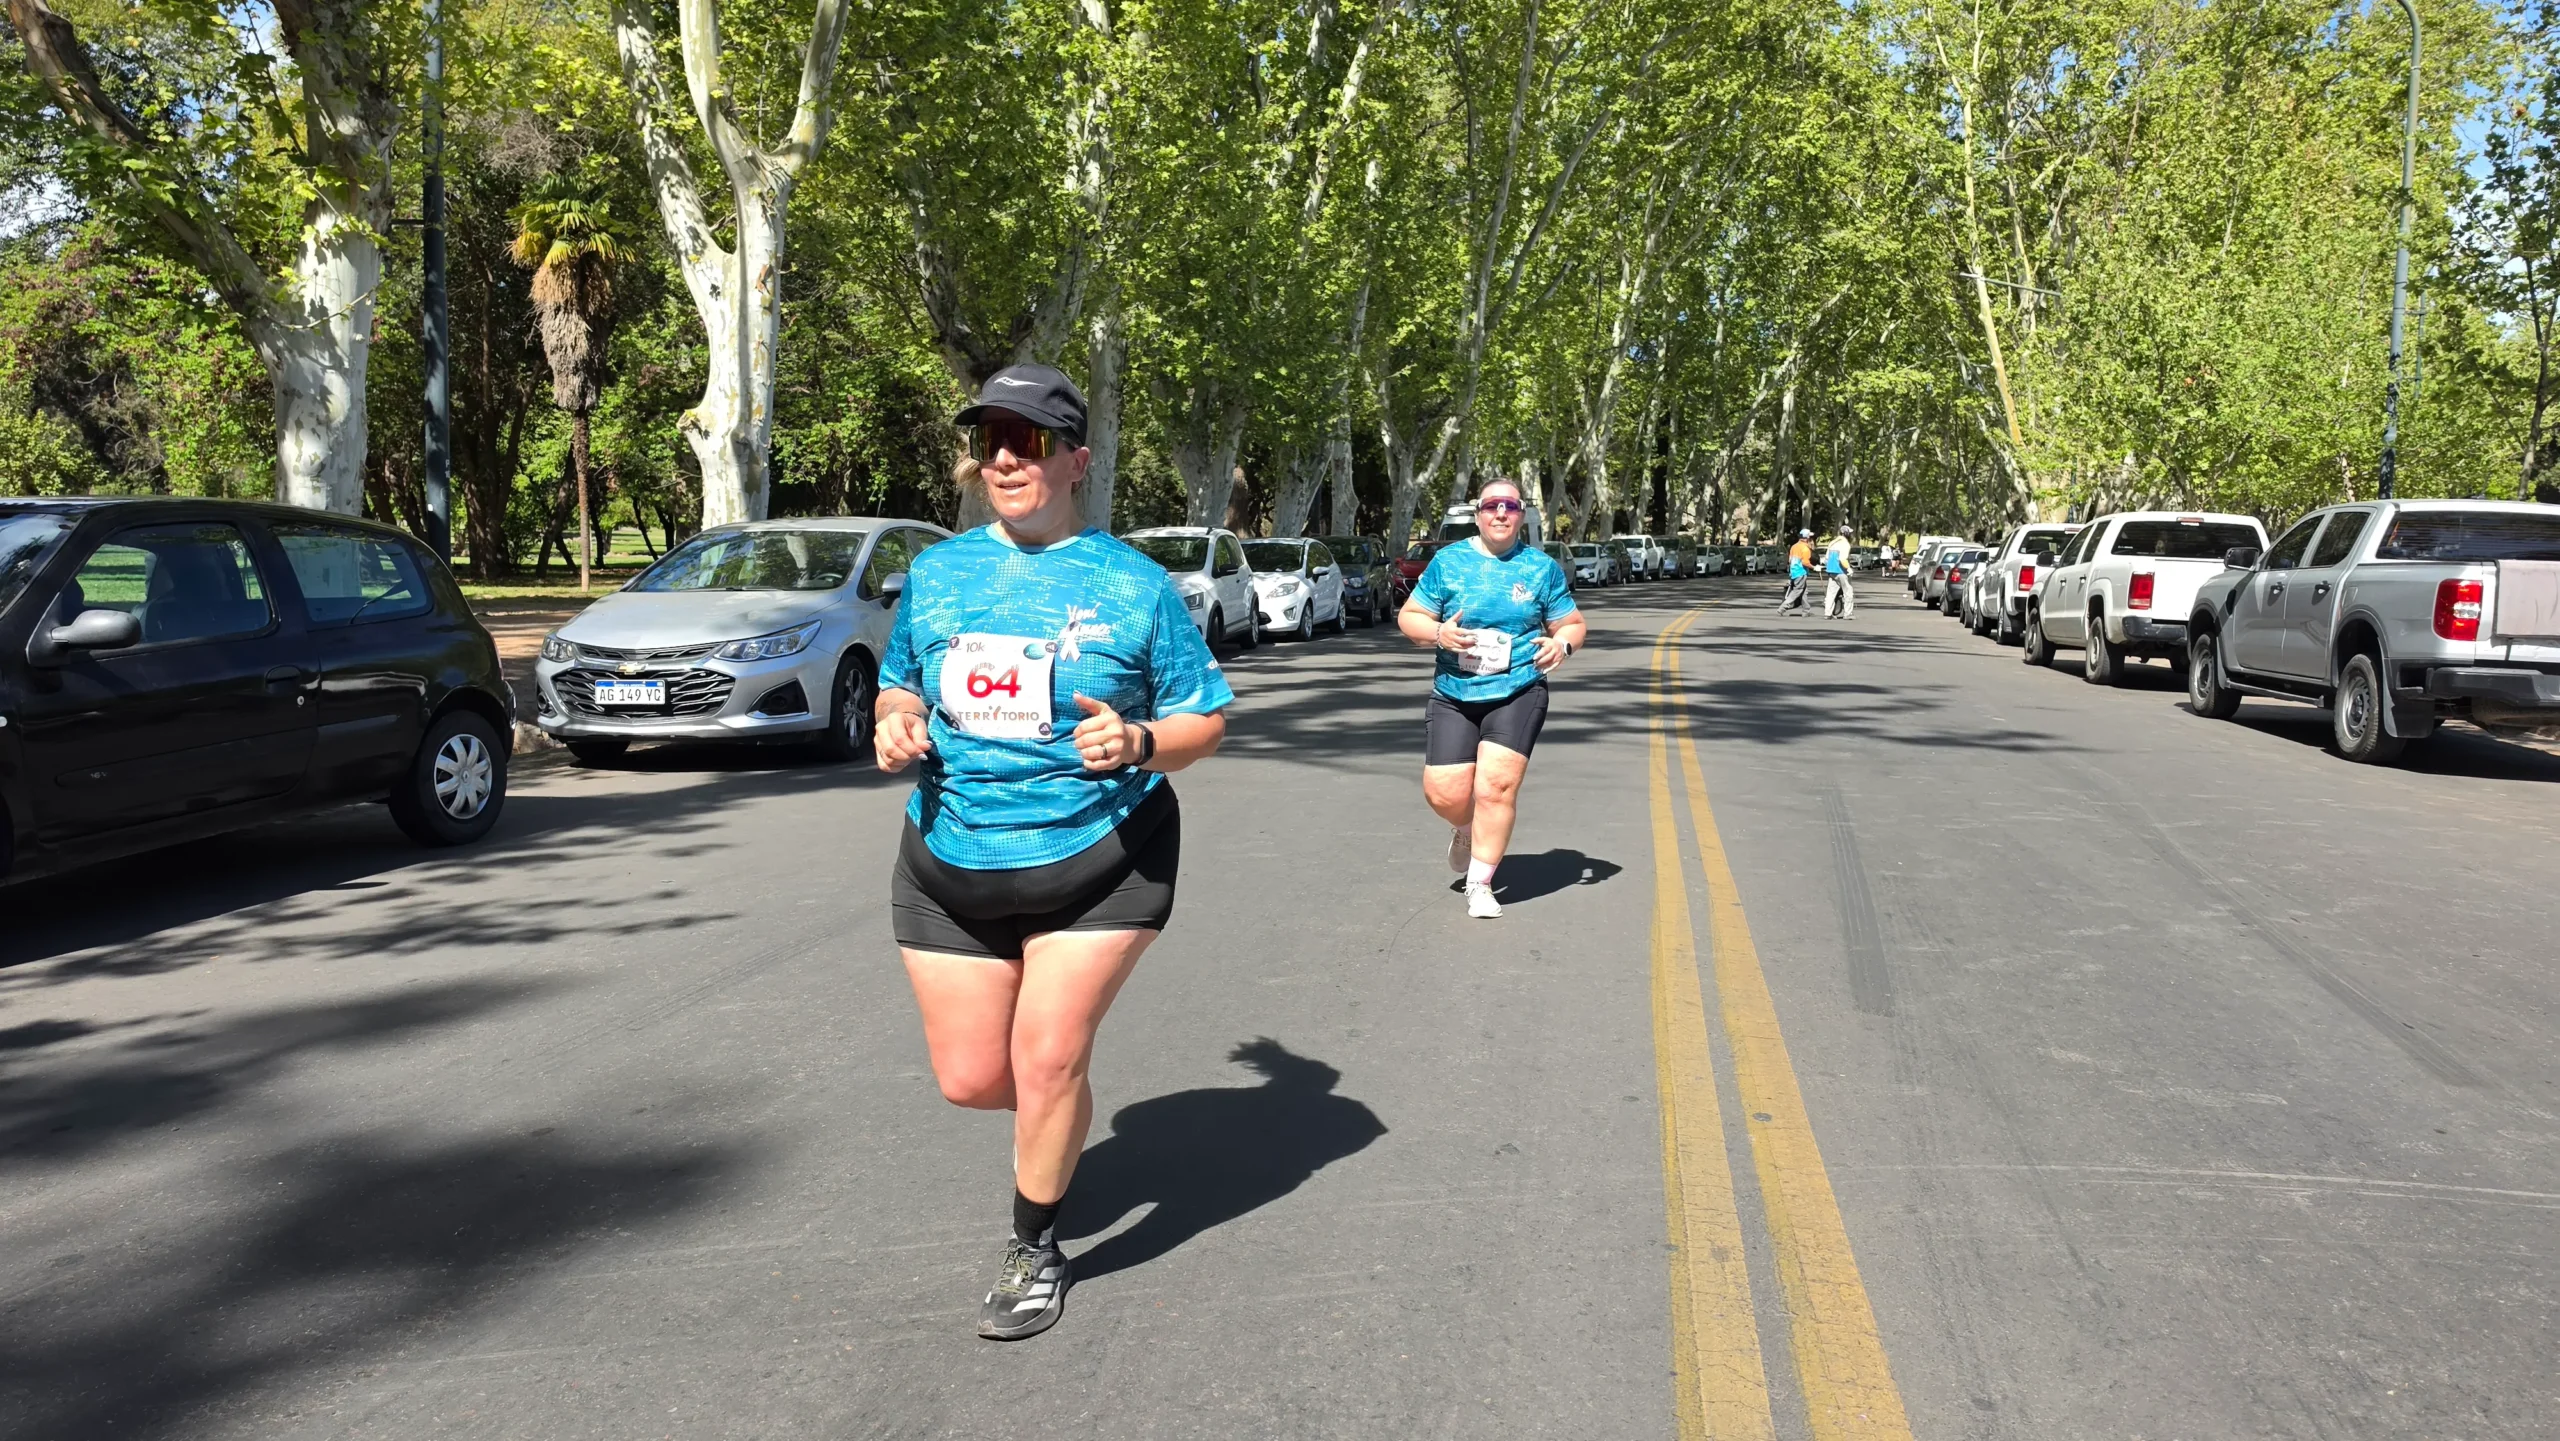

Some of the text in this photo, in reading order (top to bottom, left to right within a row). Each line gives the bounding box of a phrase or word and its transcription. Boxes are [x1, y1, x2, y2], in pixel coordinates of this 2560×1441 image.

[966, 642, 986, 653] 10k
[967, 662, 1022, 698] 64
[600, 688, 614, 701] AG
[619, 688, 642, 701] 149
[957, 705, 1040, 721] TERRITORIO
